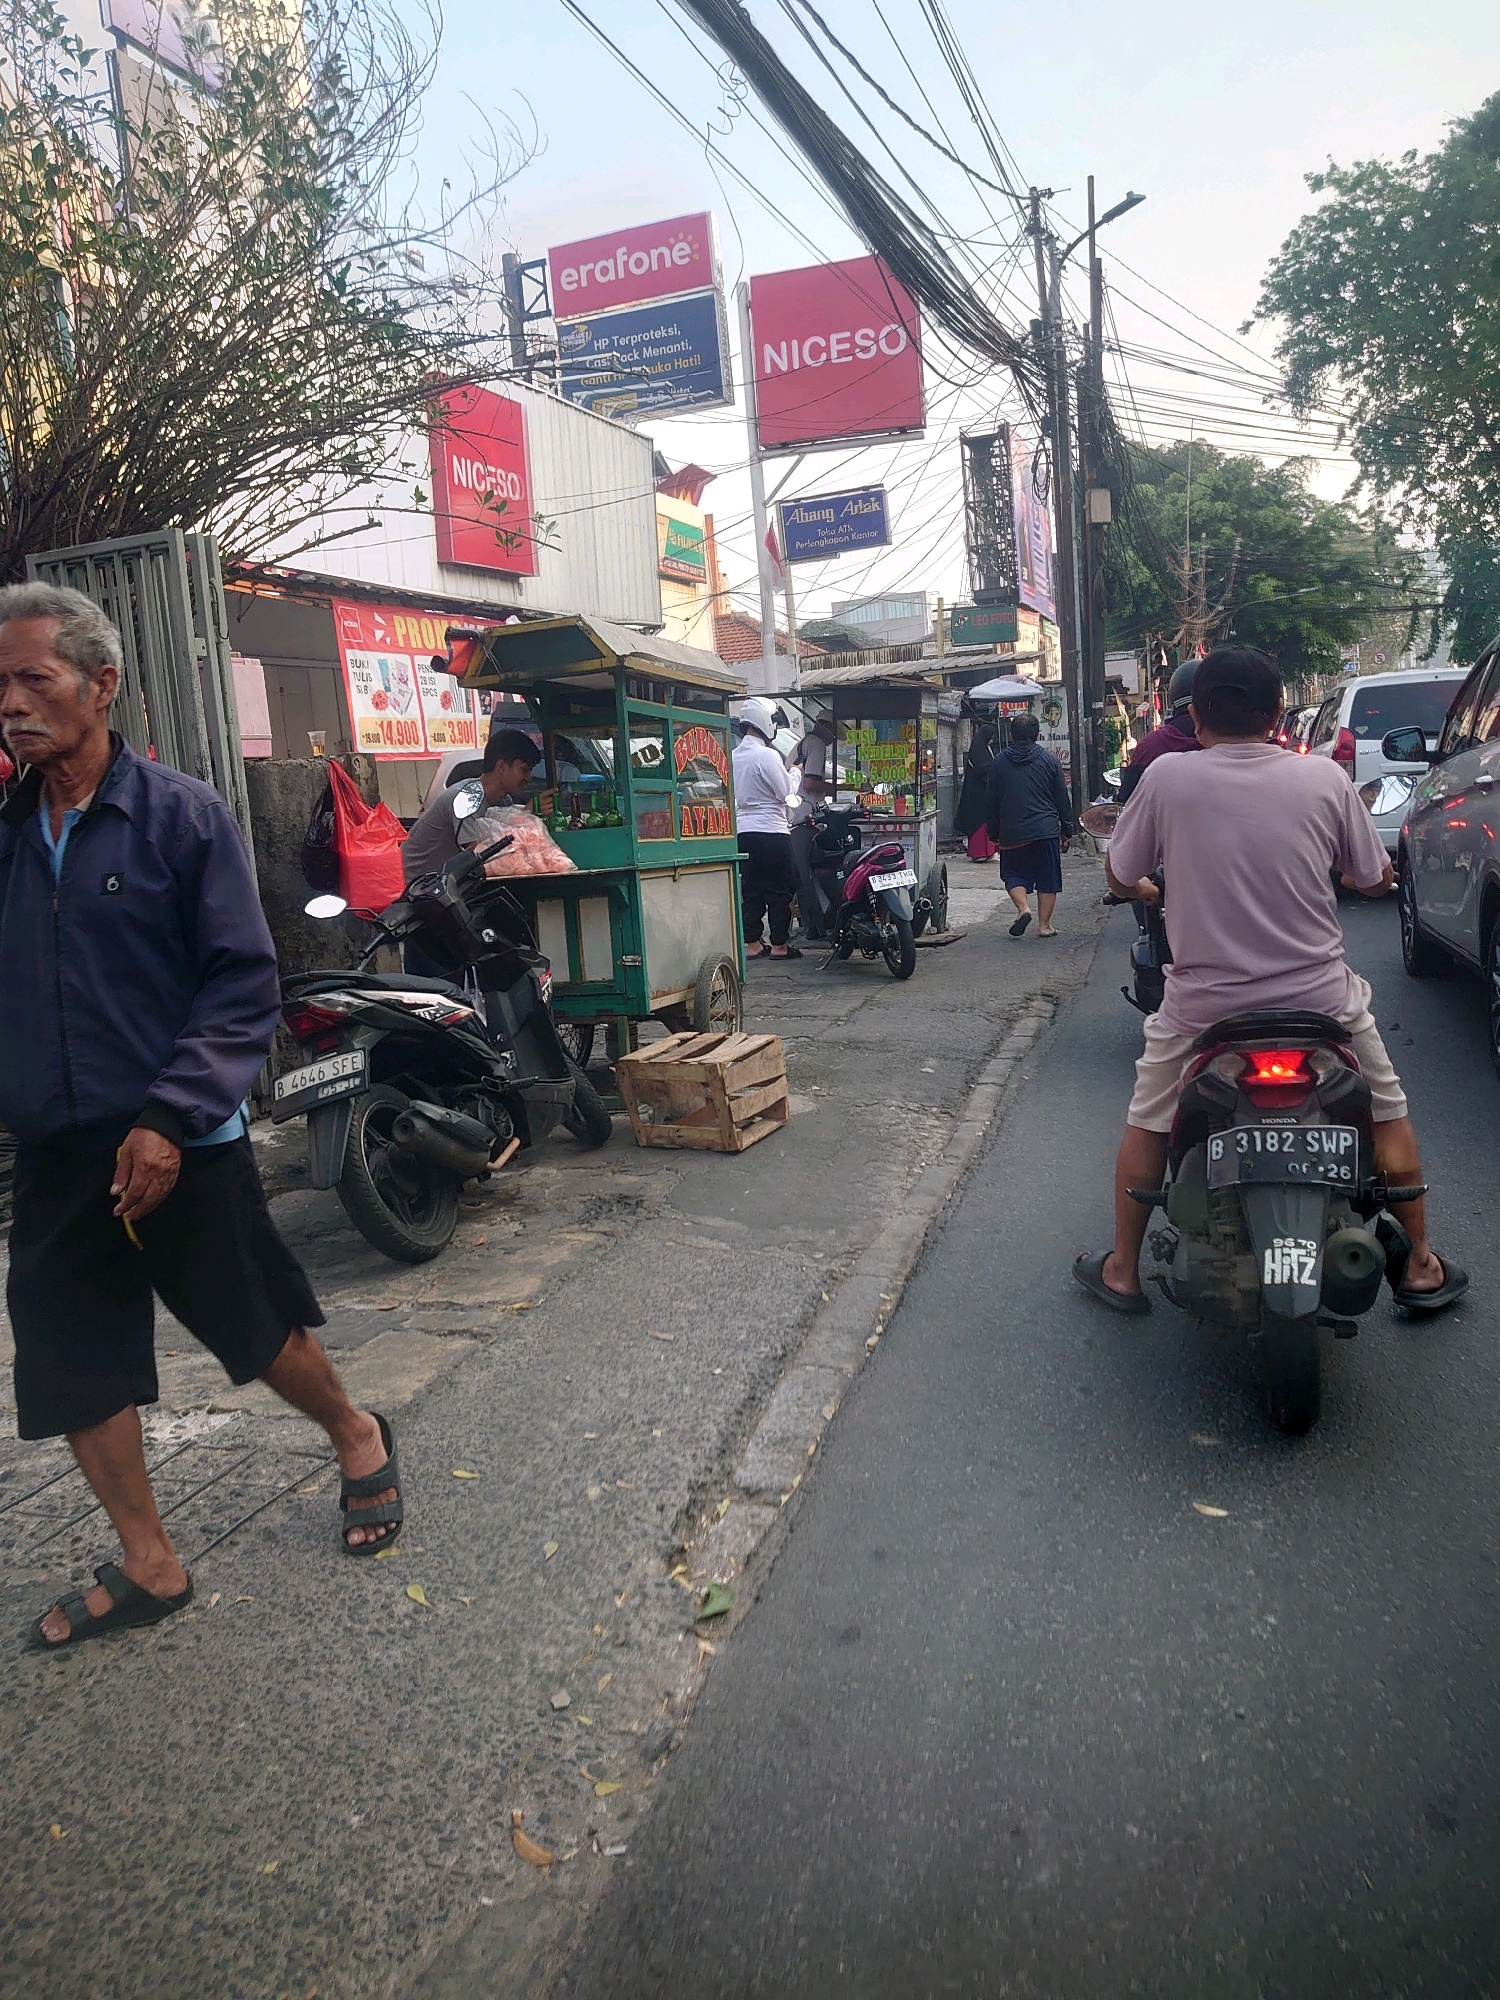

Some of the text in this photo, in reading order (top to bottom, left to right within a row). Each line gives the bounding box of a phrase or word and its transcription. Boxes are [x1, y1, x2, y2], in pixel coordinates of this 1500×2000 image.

[560, 241, 691, 291] erafone
[594, 324, 681, 351] HP Terproteksi,
[643, 339, 692, 358] Menanti,
[763, 327, 908, 373] NICESO
[674, 353, 701, 369] Hati!
[453, 454, 520, 500] NICESO
[971, 614, 989, 626] LEO
[990, 612, 1013, 625] FOTO
[353, 672, 372, 682] TULIS
[378, 720, 420, 745] 14.900
[847, 729, 877, 745] SUSU
[674, 727, 729, 787] BUBUR
[858, 744, 909, 760] KEDELAI
[845, 765, 907, 789] Rp. 5.000
[682, 806, 730, 836] AYAM
[277, 1055, 360, 1098] B 4646 SFE
[1261, 1117, 1298, 1125] HONDA
[1211, 1130, 1353, 1161] B 3182 SWP
